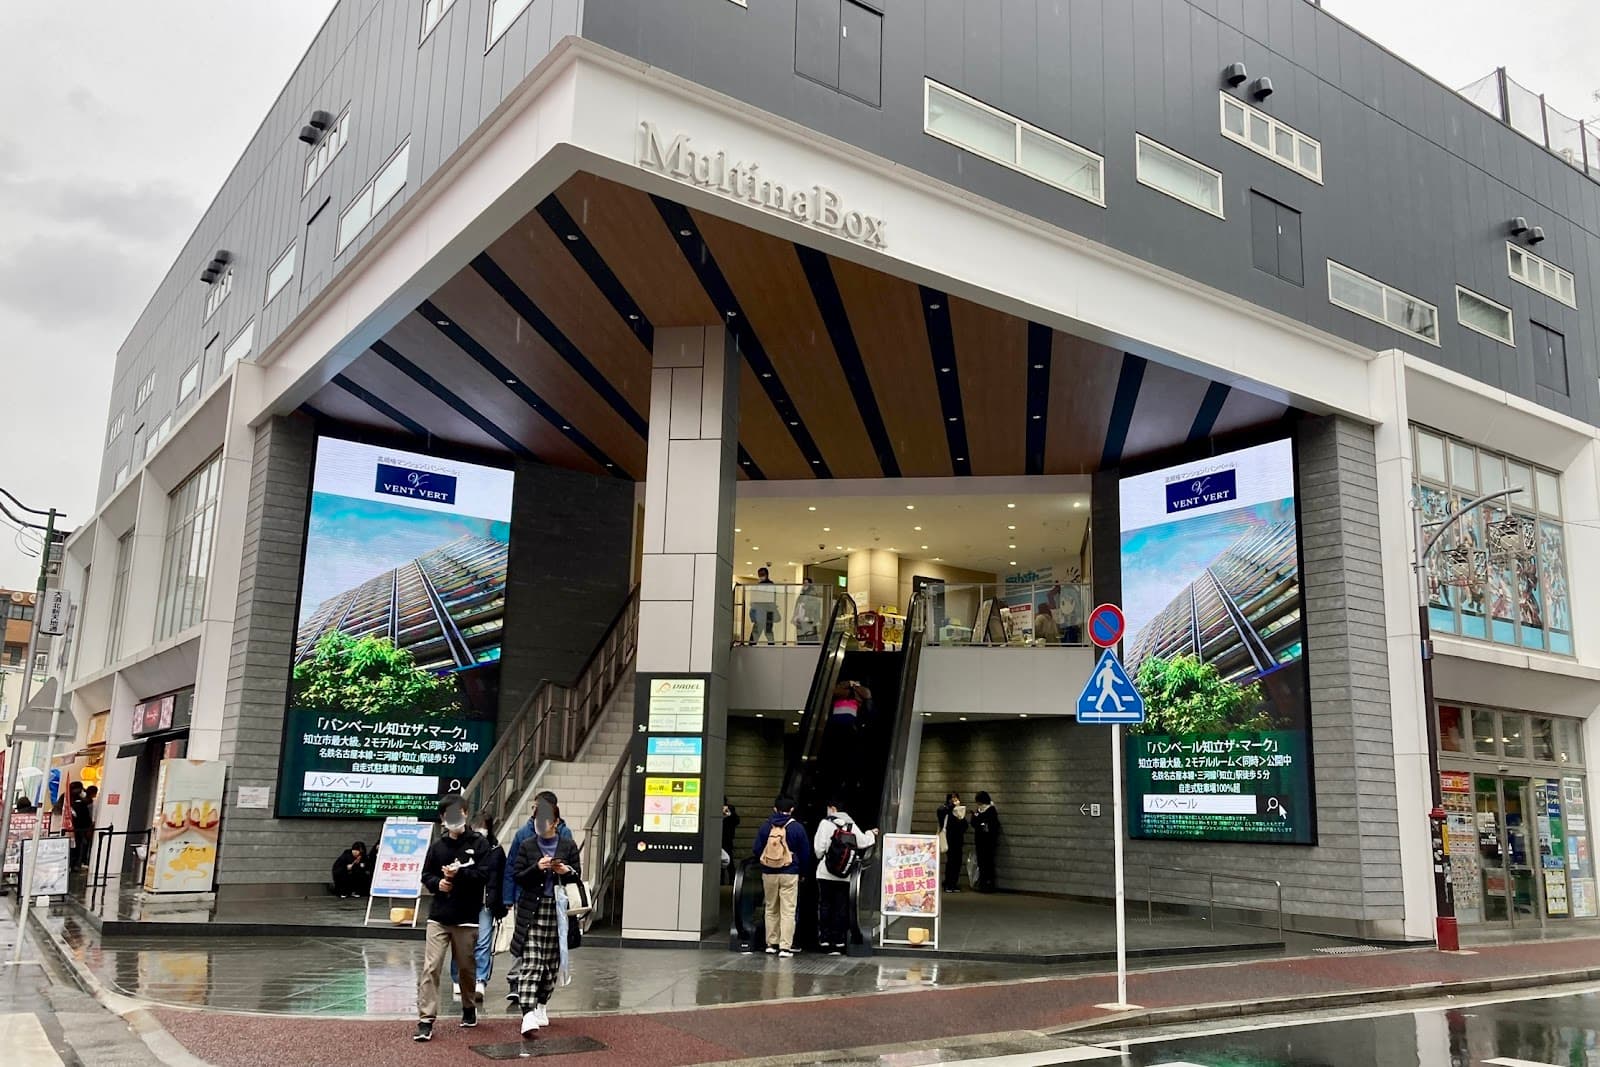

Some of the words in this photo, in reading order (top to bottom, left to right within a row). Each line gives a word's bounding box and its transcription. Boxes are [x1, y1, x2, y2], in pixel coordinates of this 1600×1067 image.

[637, 119, 888, 249] MultinaBox
[384, 483, 416, 495] VENT
[419, 489, 449, 500] VERT
[1173, 497, 1200, 509] VENT
[1203, 490, 1230, 502] VERT
[316, 717, 468, 740] 「バンベール知立ザ・マーク」
[1147, 738, 1278, 754] 「バンベール知立ザ・マーク」
[311, 775, 373, 789] バンベール
[1149, 798, 1198, 809] バンベール
